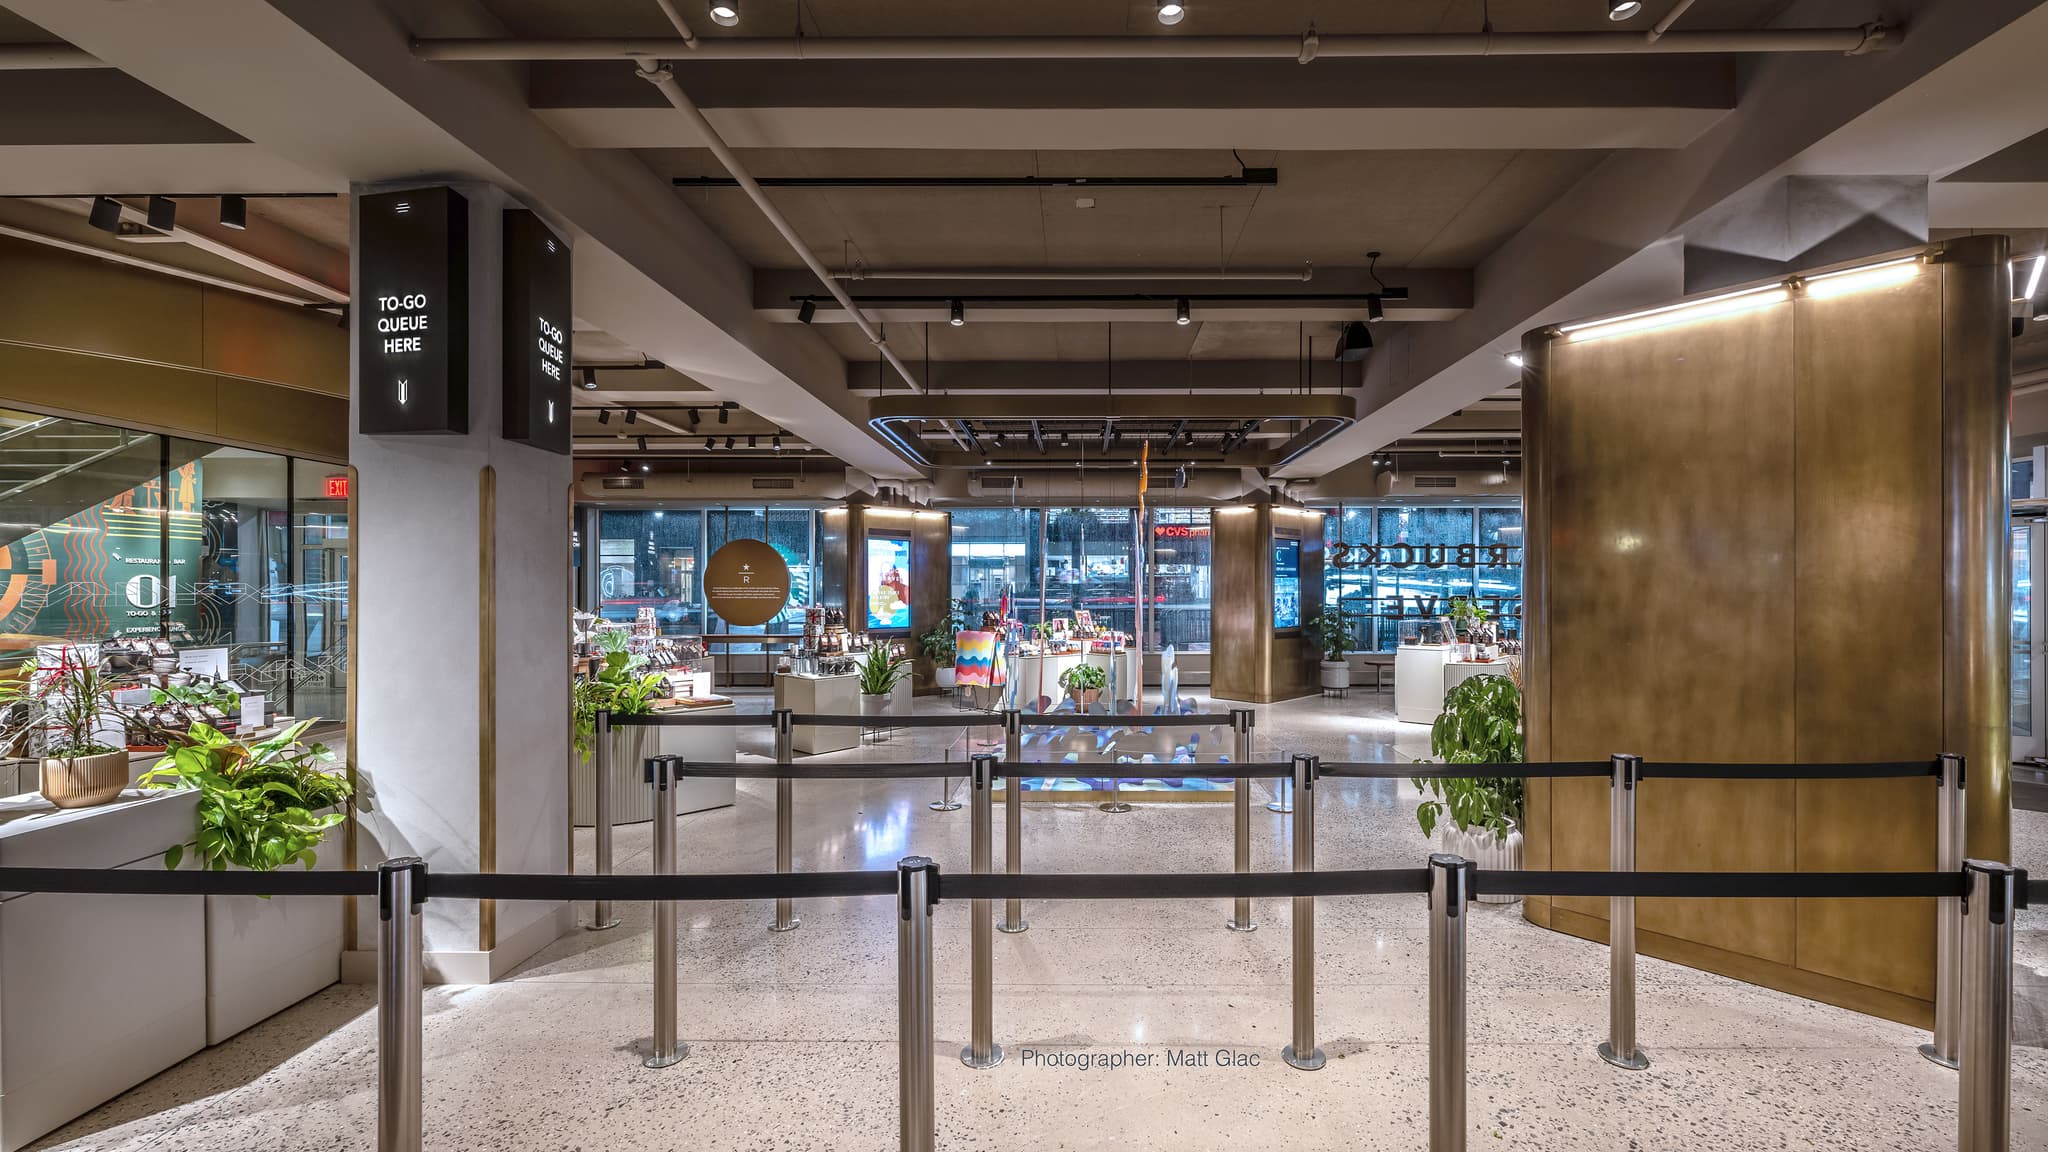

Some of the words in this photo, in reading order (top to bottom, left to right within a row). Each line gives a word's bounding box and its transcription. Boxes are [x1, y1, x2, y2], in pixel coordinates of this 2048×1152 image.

[378, 294, 427, 311] TO-GO
[377, 315, 428, 332] QUEUE
[539, 317, 563, 344] TO-GO
[384, 337, 421, 353] HERE
[539, 338, 563, 363] QUEUE
[542, 359, 560, 380] HERE
[329, 480, 348, 496] EXIT
[1166, 526, 1188, 536] CVS
[743, 576, 750, 584] R
[126, 626, 161, 634] EXPERIENC
